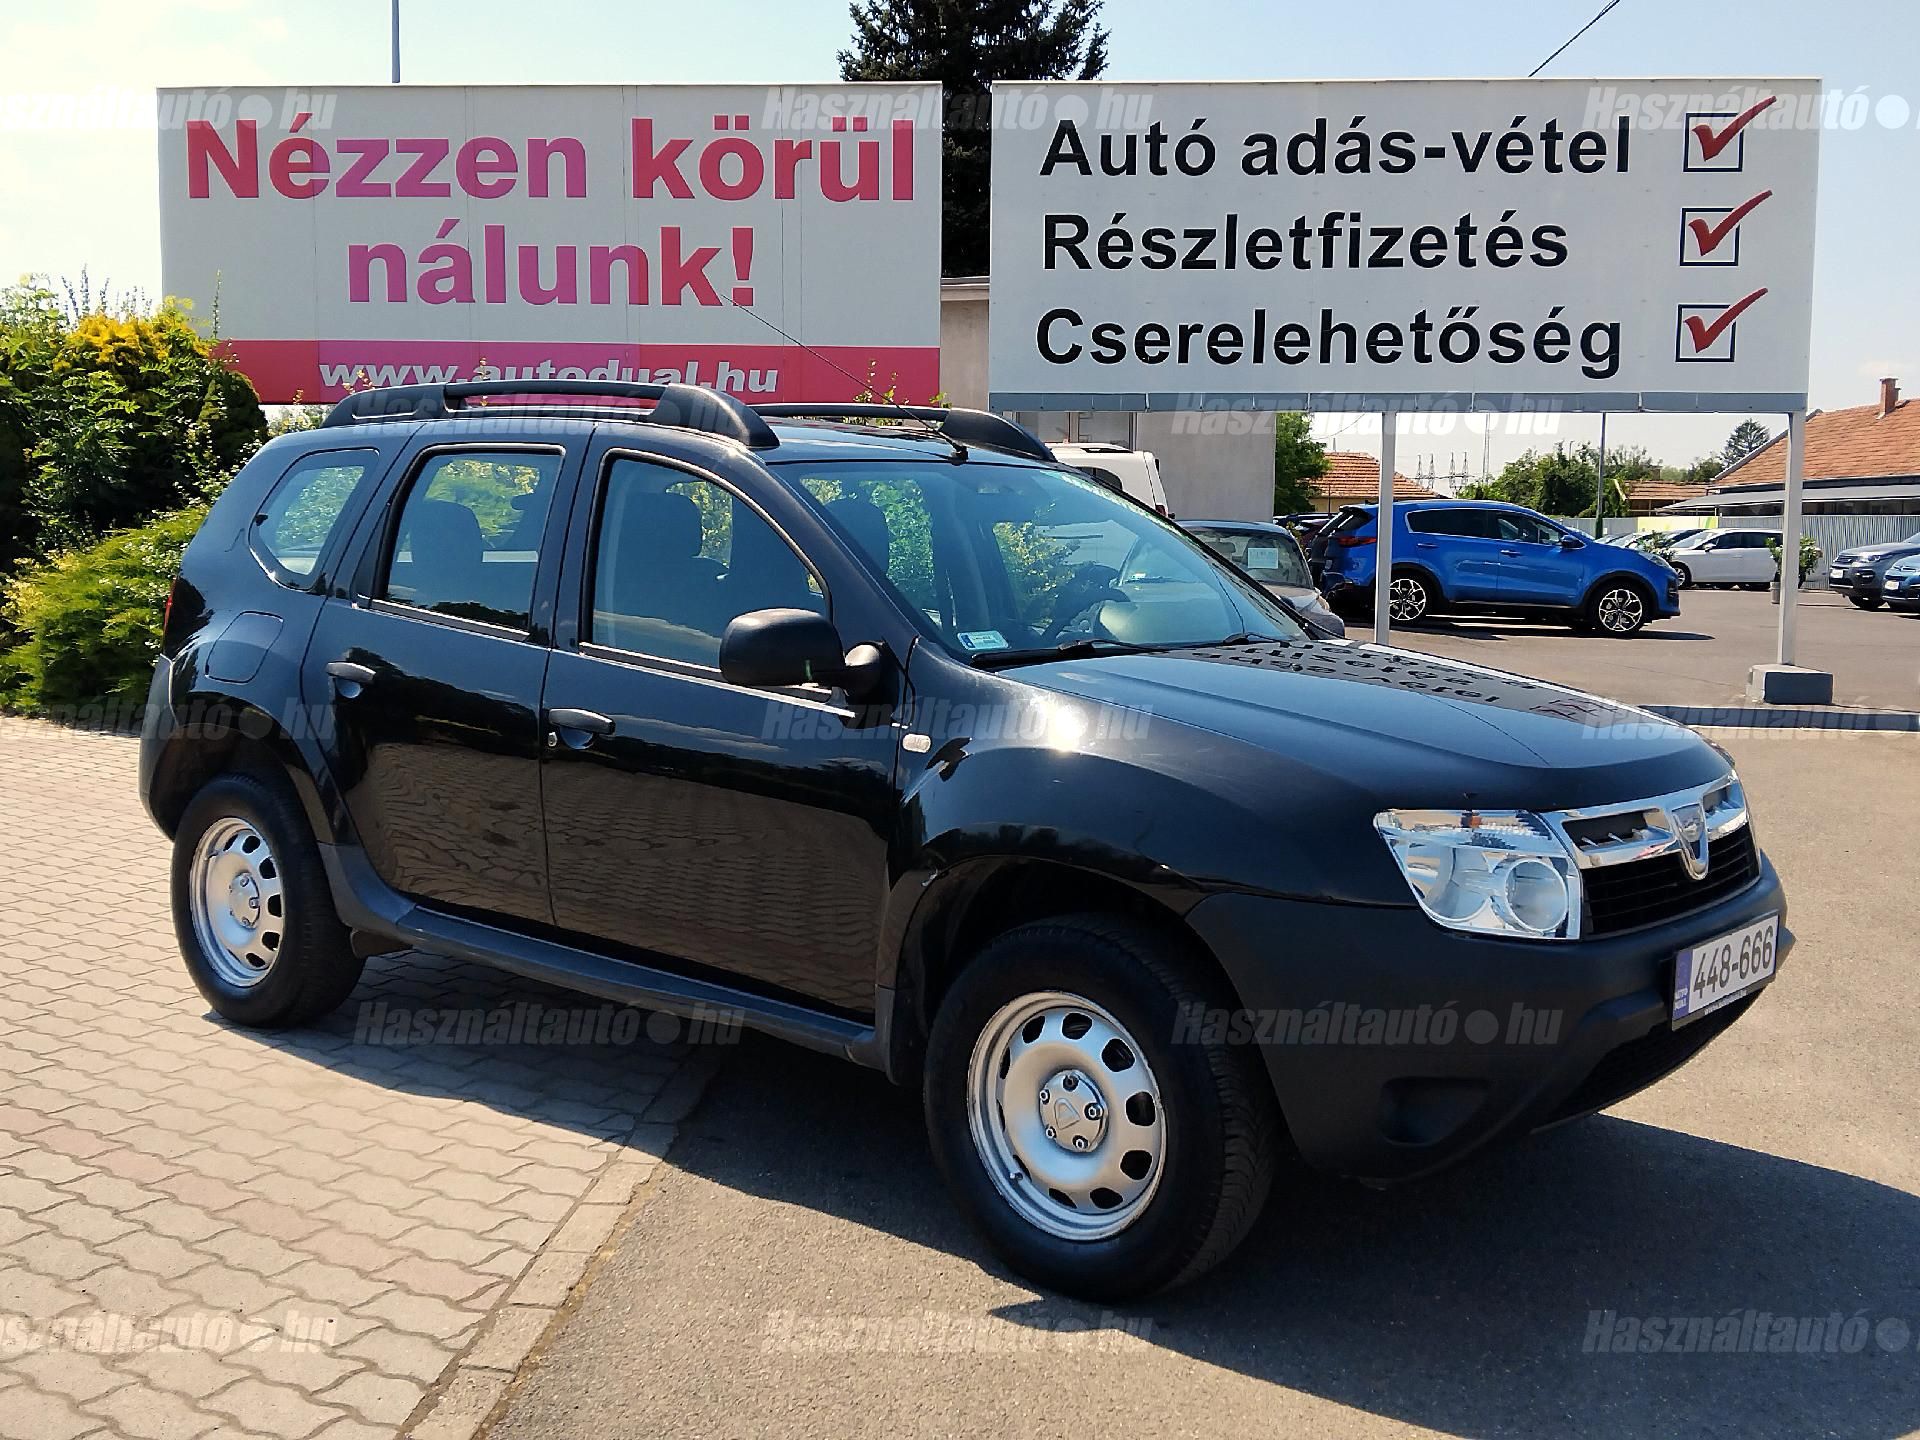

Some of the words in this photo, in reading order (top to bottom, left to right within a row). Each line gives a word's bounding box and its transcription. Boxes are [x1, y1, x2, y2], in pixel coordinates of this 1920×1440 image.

[185, 111, 588, 200] Nézzen
[631, 114, 915, 202] körül
[1039, 117, 1216, 177] Autó
[1241, 115, 1630, 176] adás-vétel
[347, 217, 754, 307] nálunk!
[1044, 209, 1568, 270] Részletfizetés
[1036, 305, 1621, 379] Cserelehetőség
[1693, 925, 1774, 999] 448-666
